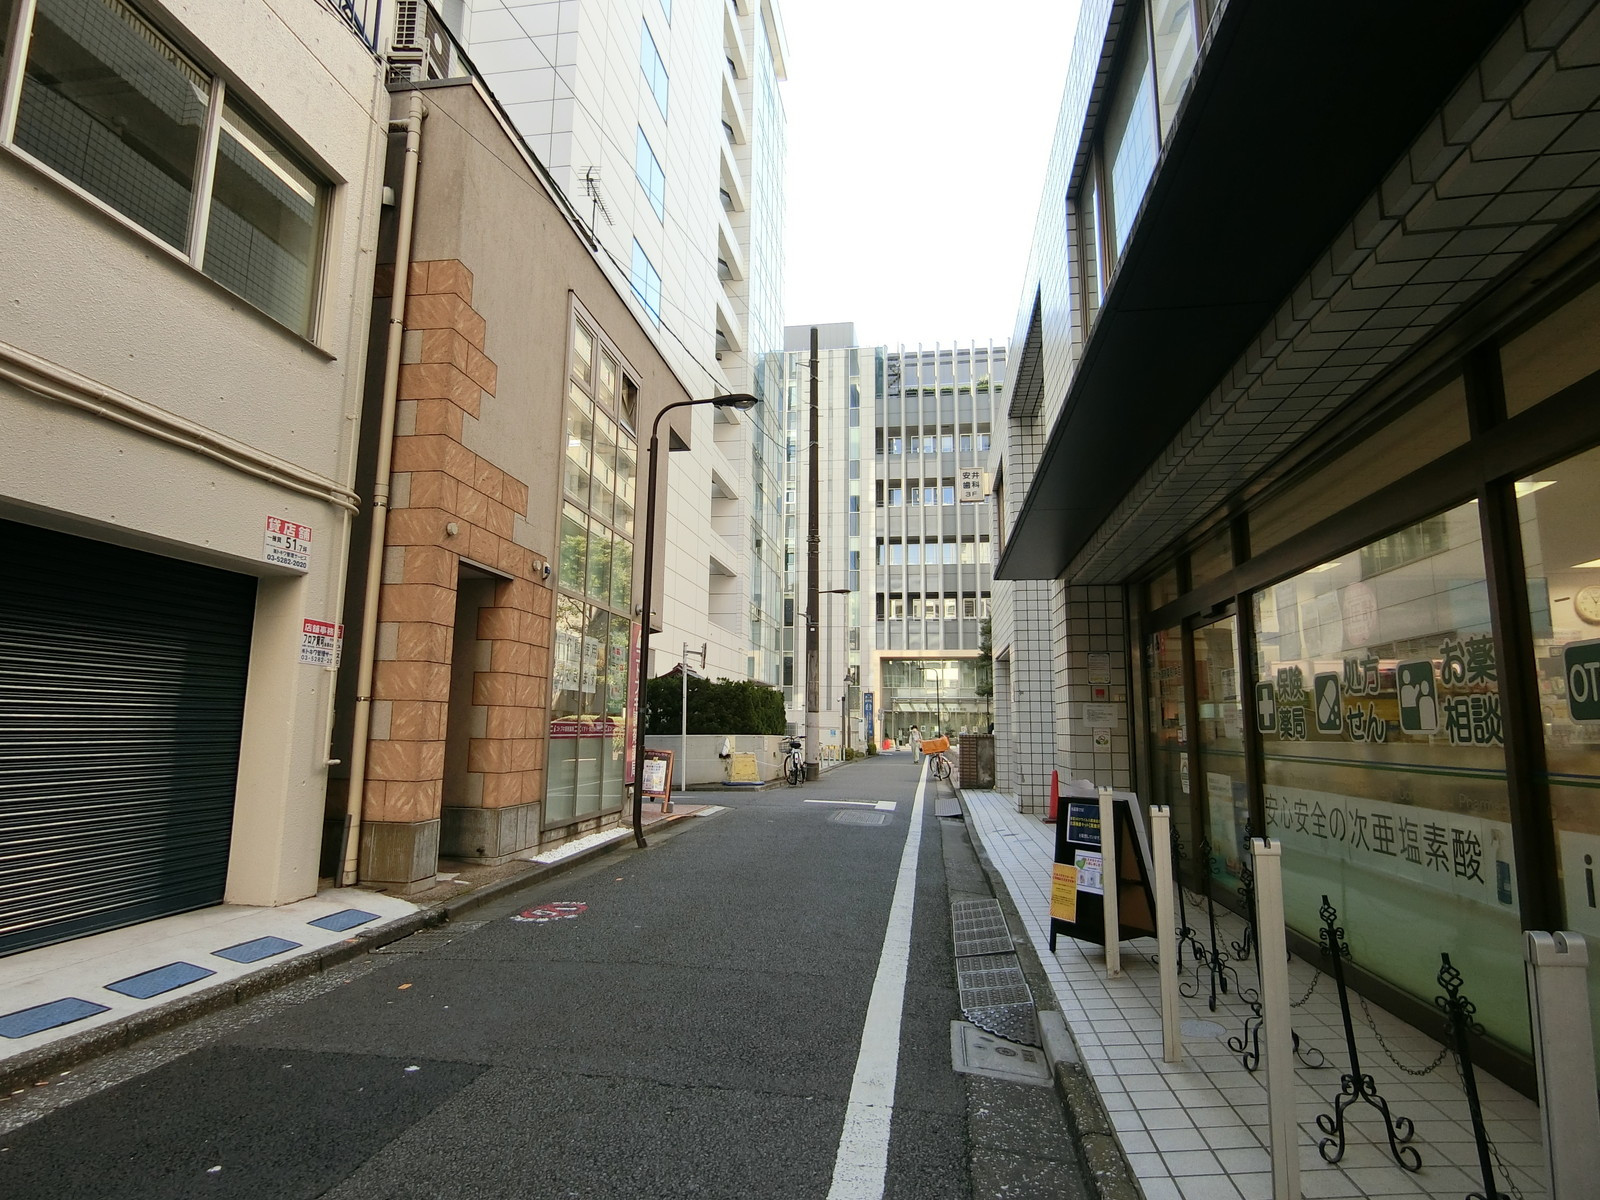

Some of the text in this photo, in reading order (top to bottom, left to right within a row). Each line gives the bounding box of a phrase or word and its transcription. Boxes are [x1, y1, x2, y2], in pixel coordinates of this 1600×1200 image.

[962, 472, 979, 480] 安井
[962, 481, 979, 489] 歯科
[267, 517, 311, 541] 貸店舗
[266, 553, 307, 569] 03-5282-2020
[1344, 655, 1381, 696] 処方
[1440, 634, 1497, 686] お薬
[1277, 665, 1304, 700] 保険
[1278, 706, 1306, 741] 薬局
[1346, 702, 1385, 742] せん
[1444, 694, 1503, 746] 相談
[1265, 793, 1485, 884] 安心安全の次亜塩素酸
